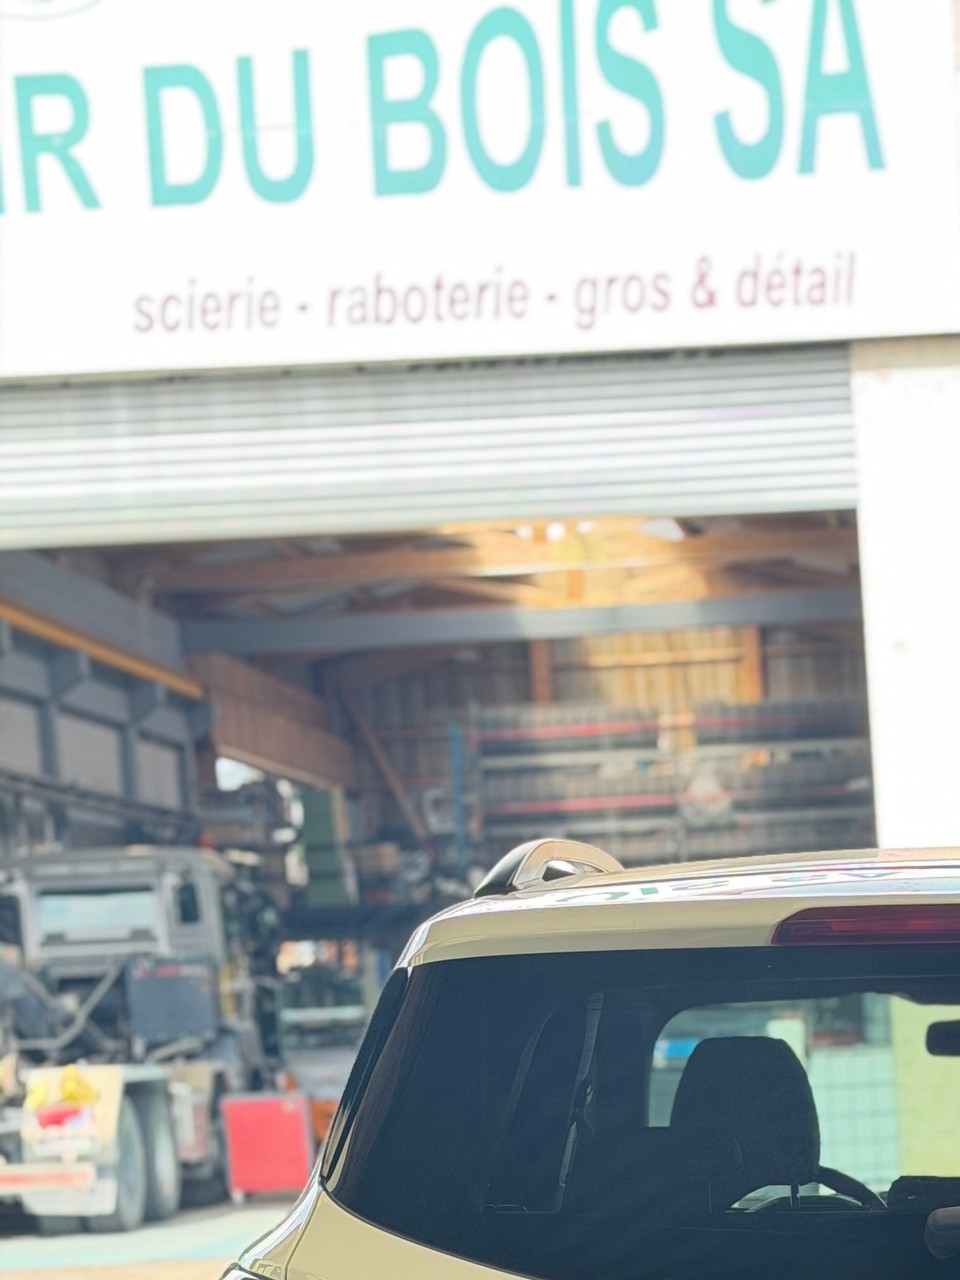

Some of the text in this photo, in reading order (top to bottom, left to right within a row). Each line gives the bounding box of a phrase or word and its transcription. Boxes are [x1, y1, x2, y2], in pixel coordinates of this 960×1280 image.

[0, 0, 886, 215] R DU BOIS SA
[133, 276, 281, 333] scierie
[327, 264, 529, 326] raboterie
[574, 271, 673, 331] gros
[690, 255, 718, 309] &
[736, 249, 856, 309] détail
